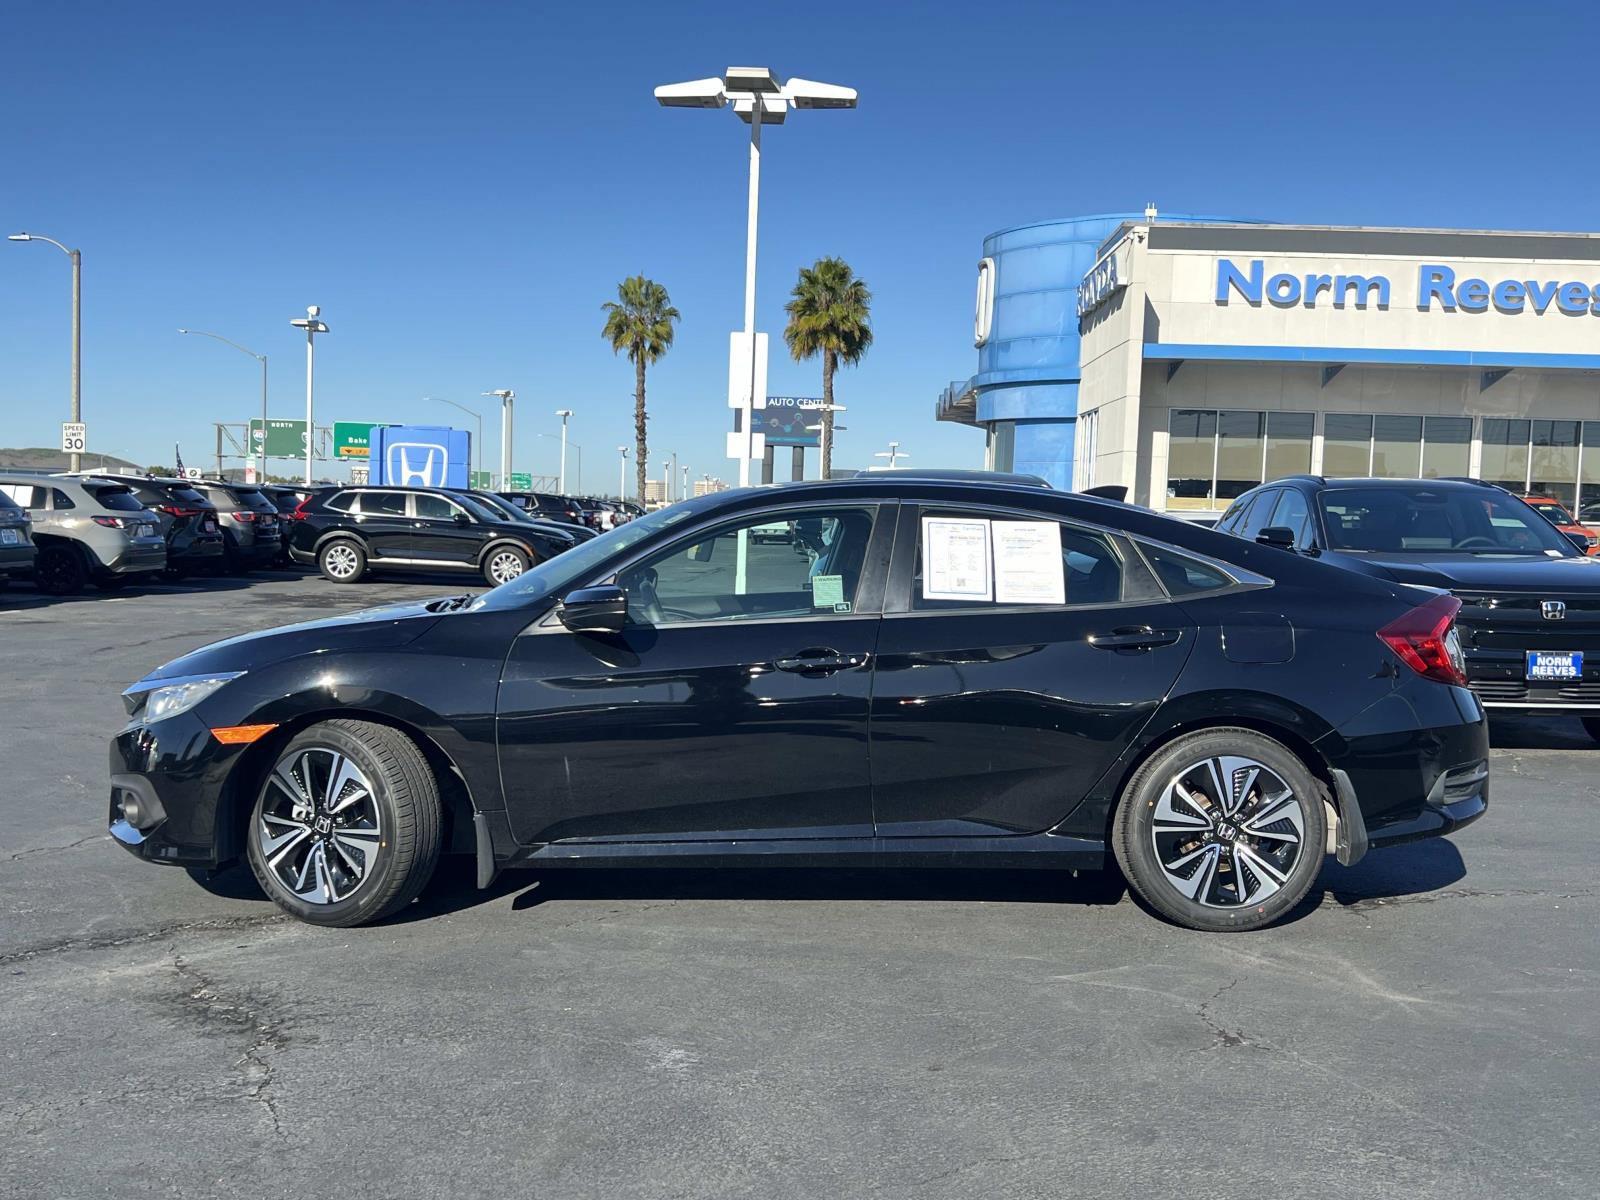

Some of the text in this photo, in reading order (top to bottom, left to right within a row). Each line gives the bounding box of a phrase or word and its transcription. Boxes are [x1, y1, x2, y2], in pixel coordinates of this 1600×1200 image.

[1215, 259, 1391, 311] Norm
[769, 398, 824, 407] AUTO CENT
[64, 438, 83, 450] 30
[1537, 656, 1573, 667] NORM
[1532, 665, 1577, 677] REEVES
